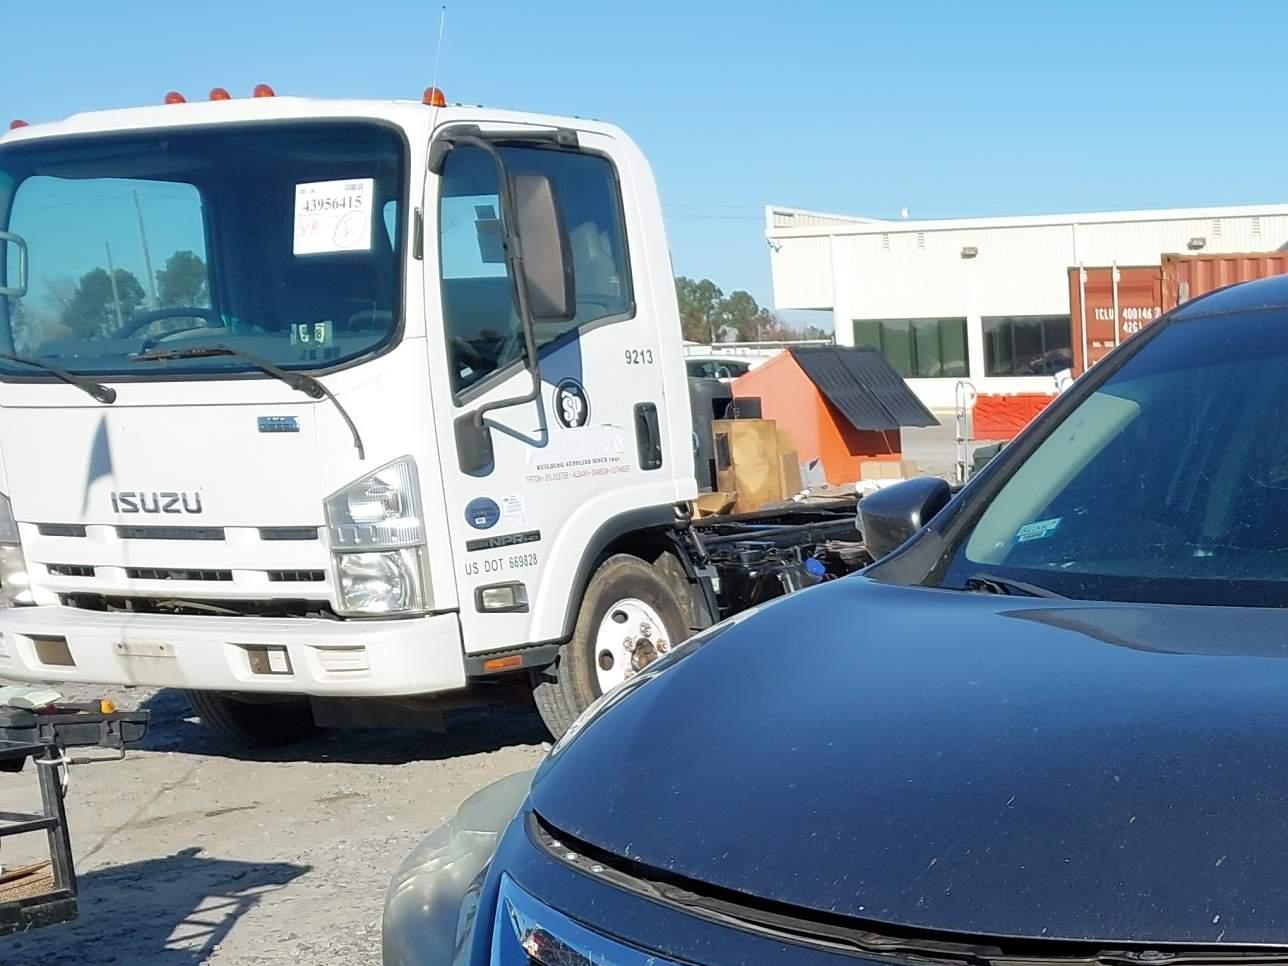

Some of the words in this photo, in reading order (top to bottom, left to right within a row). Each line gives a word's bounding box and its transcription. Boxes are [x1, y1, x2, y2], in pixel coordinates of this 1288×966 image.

[303, 195, 362, 212] 43956415
[1122, 307, 1152, 320] 400146
[624, 349, 653, 365] 9213
[110, 491, 203, 514] ISUZU
[465, 561, 479, 575] US
[484, 559, 503, 572] DOT
[509, 553, 538, 569] 669828
